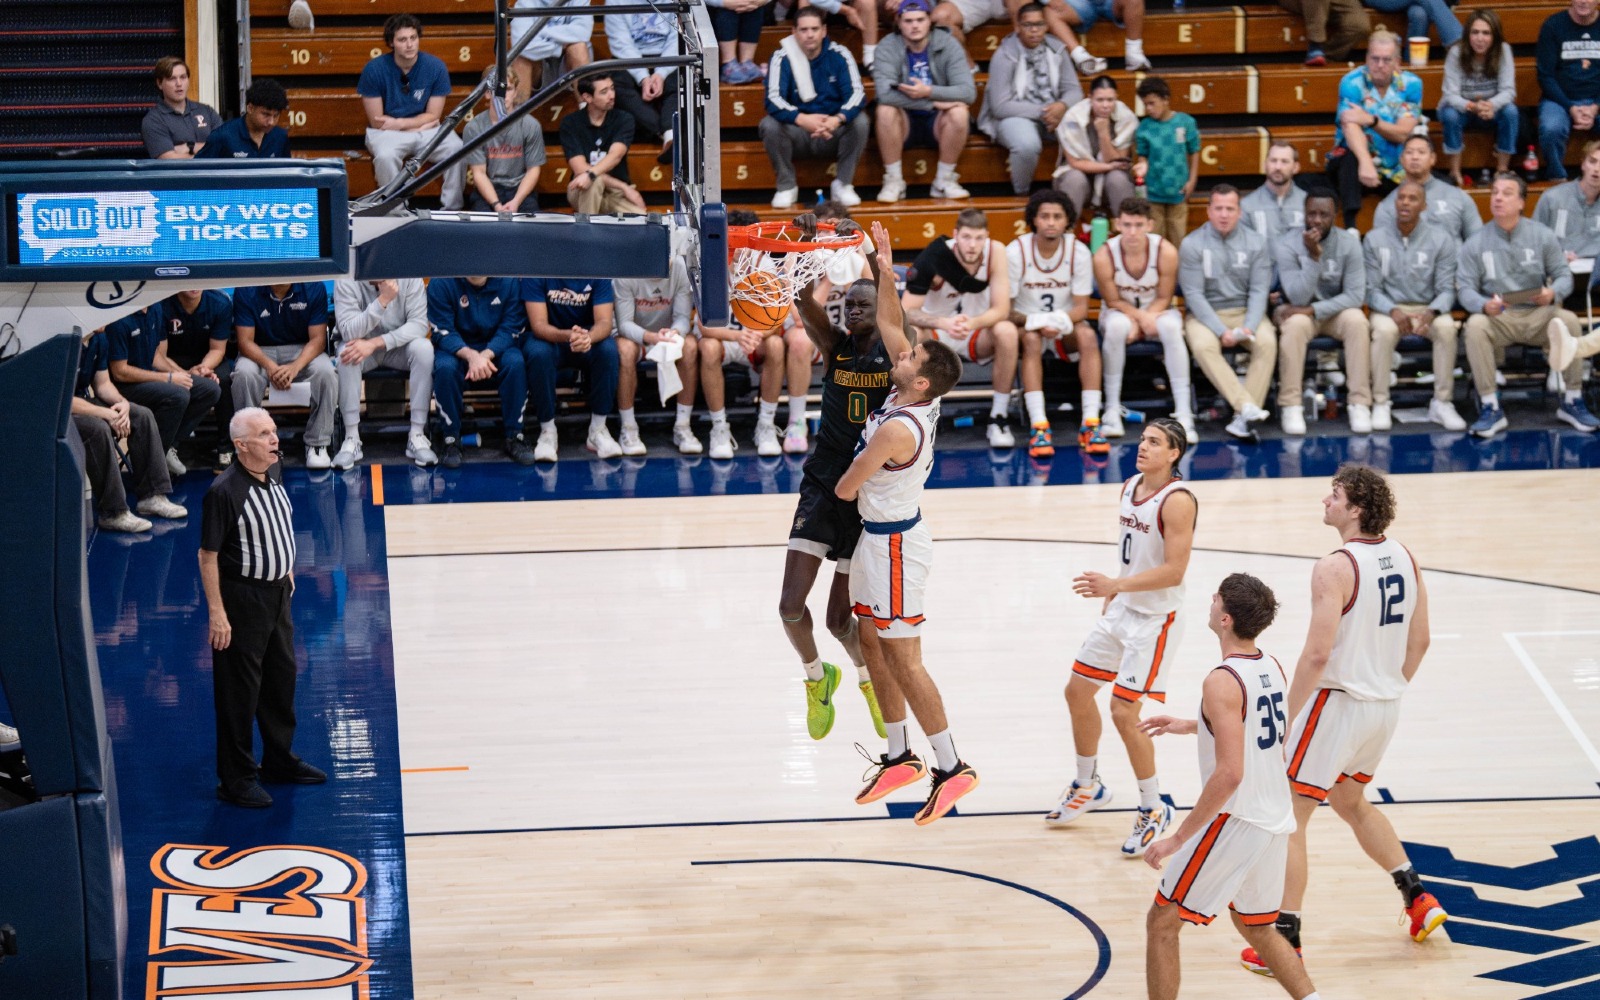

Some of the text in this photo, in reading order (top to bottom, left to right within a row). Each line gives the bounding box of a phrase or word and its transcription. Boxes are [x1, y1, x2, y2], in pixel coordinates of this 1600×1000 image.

[1178, 24, 1193, 43] E
[1283, 27, 1292, 42] 1
[985, 35, 998, 50] 2
[290, 49, 310, 65] 10
[459, 46, 471, 62] 8
[1189, 83, 1206, 104] D
[1295, 86, 1304, 100] 1
[550, 106, 564, 122] 7
[733, 101, 746, 116] 5
[288, 110, 307, 127] 10
[1201, 145, 1219, 165] C
[1308, 149, 1317, 164] 1
[555, 168, 568, 184] 7
[650, 165, 663, 181] 6
[737, 165, 749, 181] 5
[914, 159, 928, 176] 3
[36, 206, 146, 231] SOLD OUT
[165, 203, 314, 222] BUY WCC
[172, 222, 309, 241] TICKETS
[922, 222, 936, 239] 3
[1013, 220, 1027, 236] 2
[62, 247, 154, 257] SOLDOUT.COM
[1040, 293, 1055, 312] 3
[169, 318, 182, 332] P
[834, 369, 889, 388] VERMONT
[848, 391, 868, 424] 0
[1122, 532, 1132, 565] 0
[1378, 573, 1406, 627] 12
[1256, 691, 1285, 750] 35
[146, 843, 374, 1000] VES
